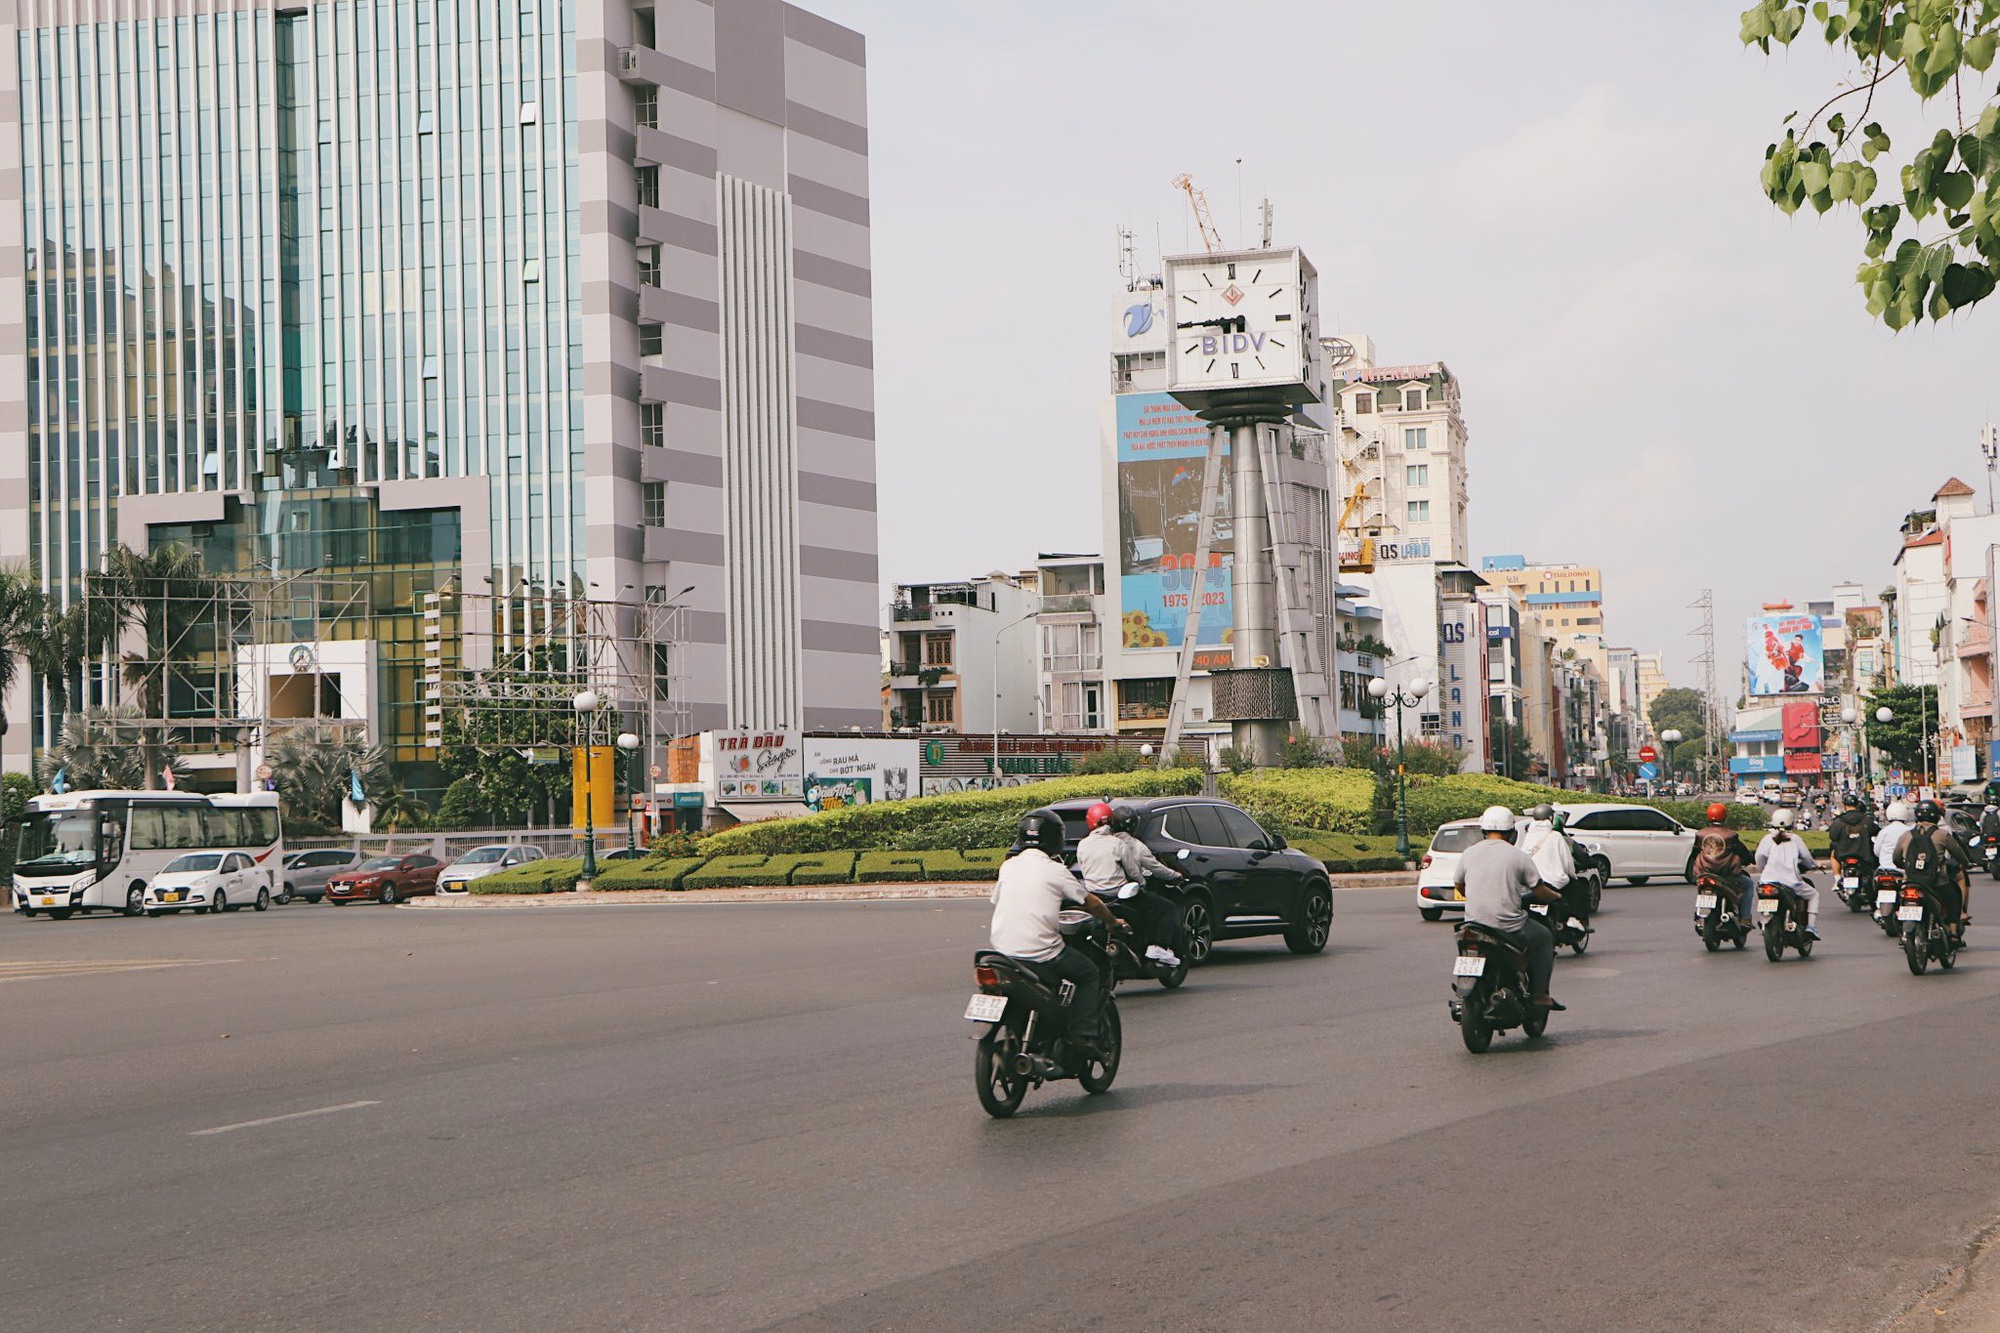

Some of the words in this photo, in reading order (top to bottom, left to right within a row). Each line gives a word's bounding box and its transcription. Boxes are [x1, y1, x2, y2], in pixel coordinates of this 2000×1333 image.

[1202, 331, 1266, 356] BIDV
[1380, 544, 1398, 560] QS
[1162, 593, 1188, 608] 1975
[1443, 622, 1465, 644] QS
[1213, 654, 1230, 666] AM
